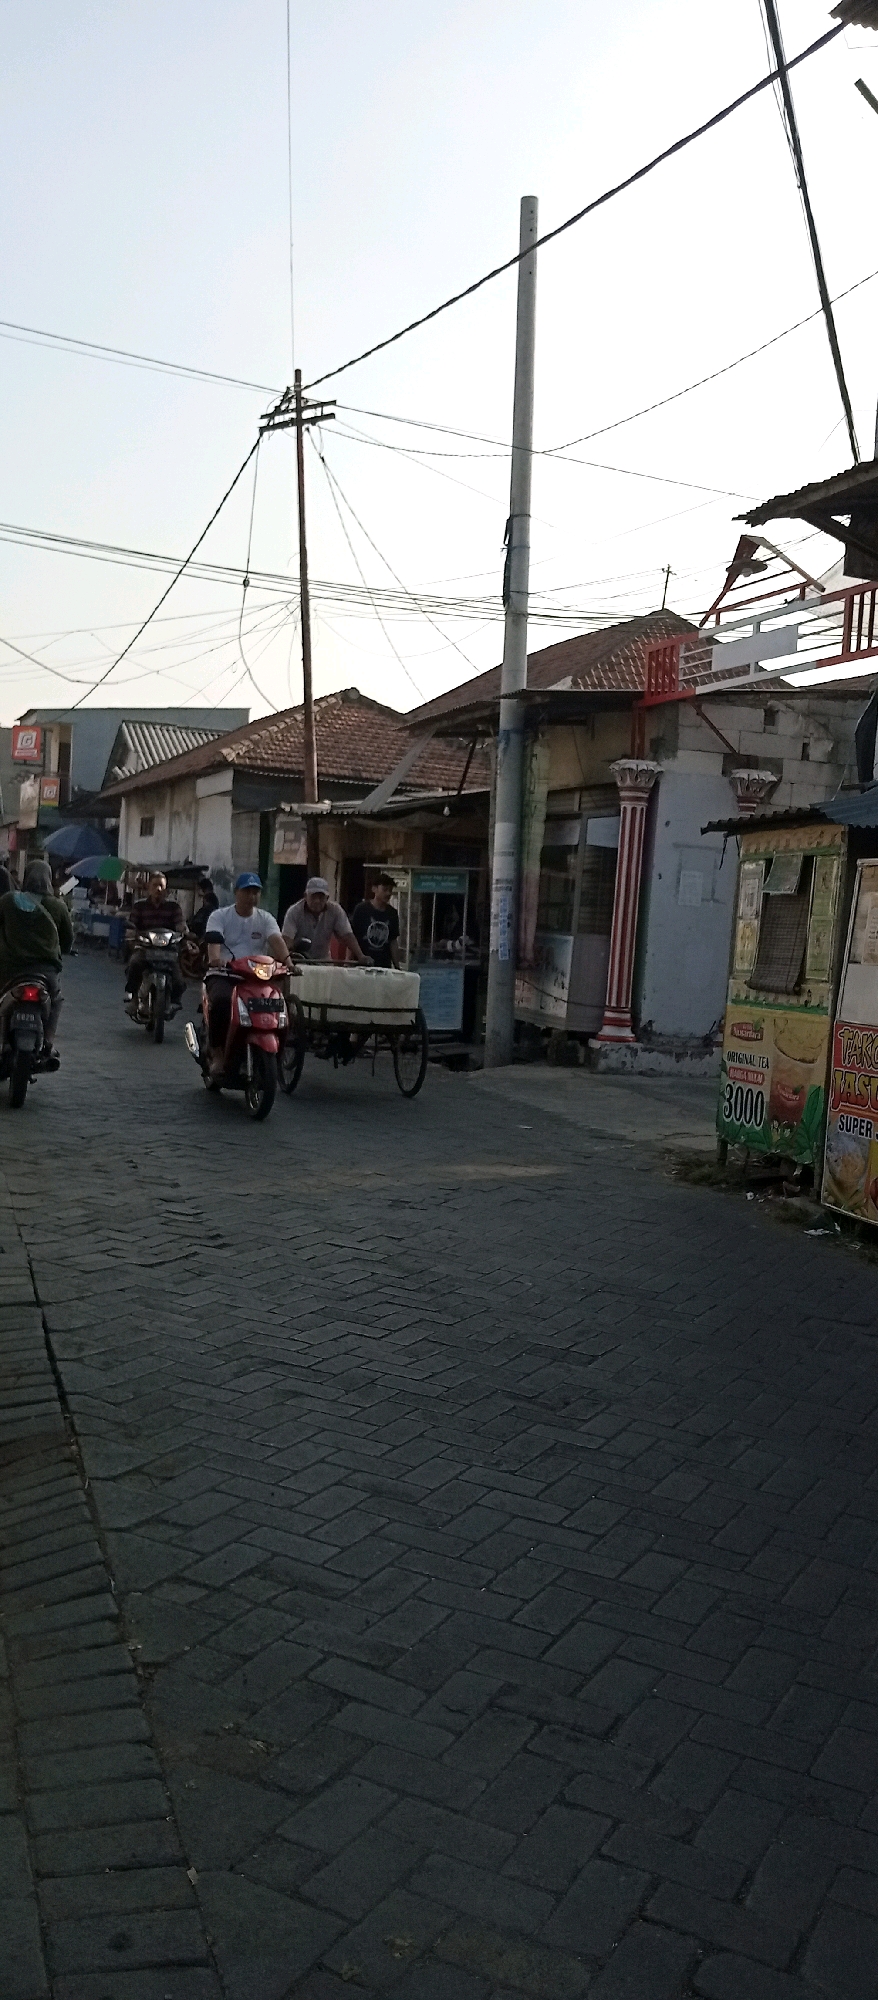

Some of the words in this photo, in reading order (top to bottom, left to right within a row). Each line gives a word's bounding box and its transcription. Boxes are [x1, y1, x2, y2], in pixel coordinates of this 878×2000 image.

[726, 1051, 756, 1067] ORIGINAL
[758, 1056, 769, 1069] TEA
[723, 1083, 765, 1128] 3000
[838, 1114, 873, 1139] SUPER
